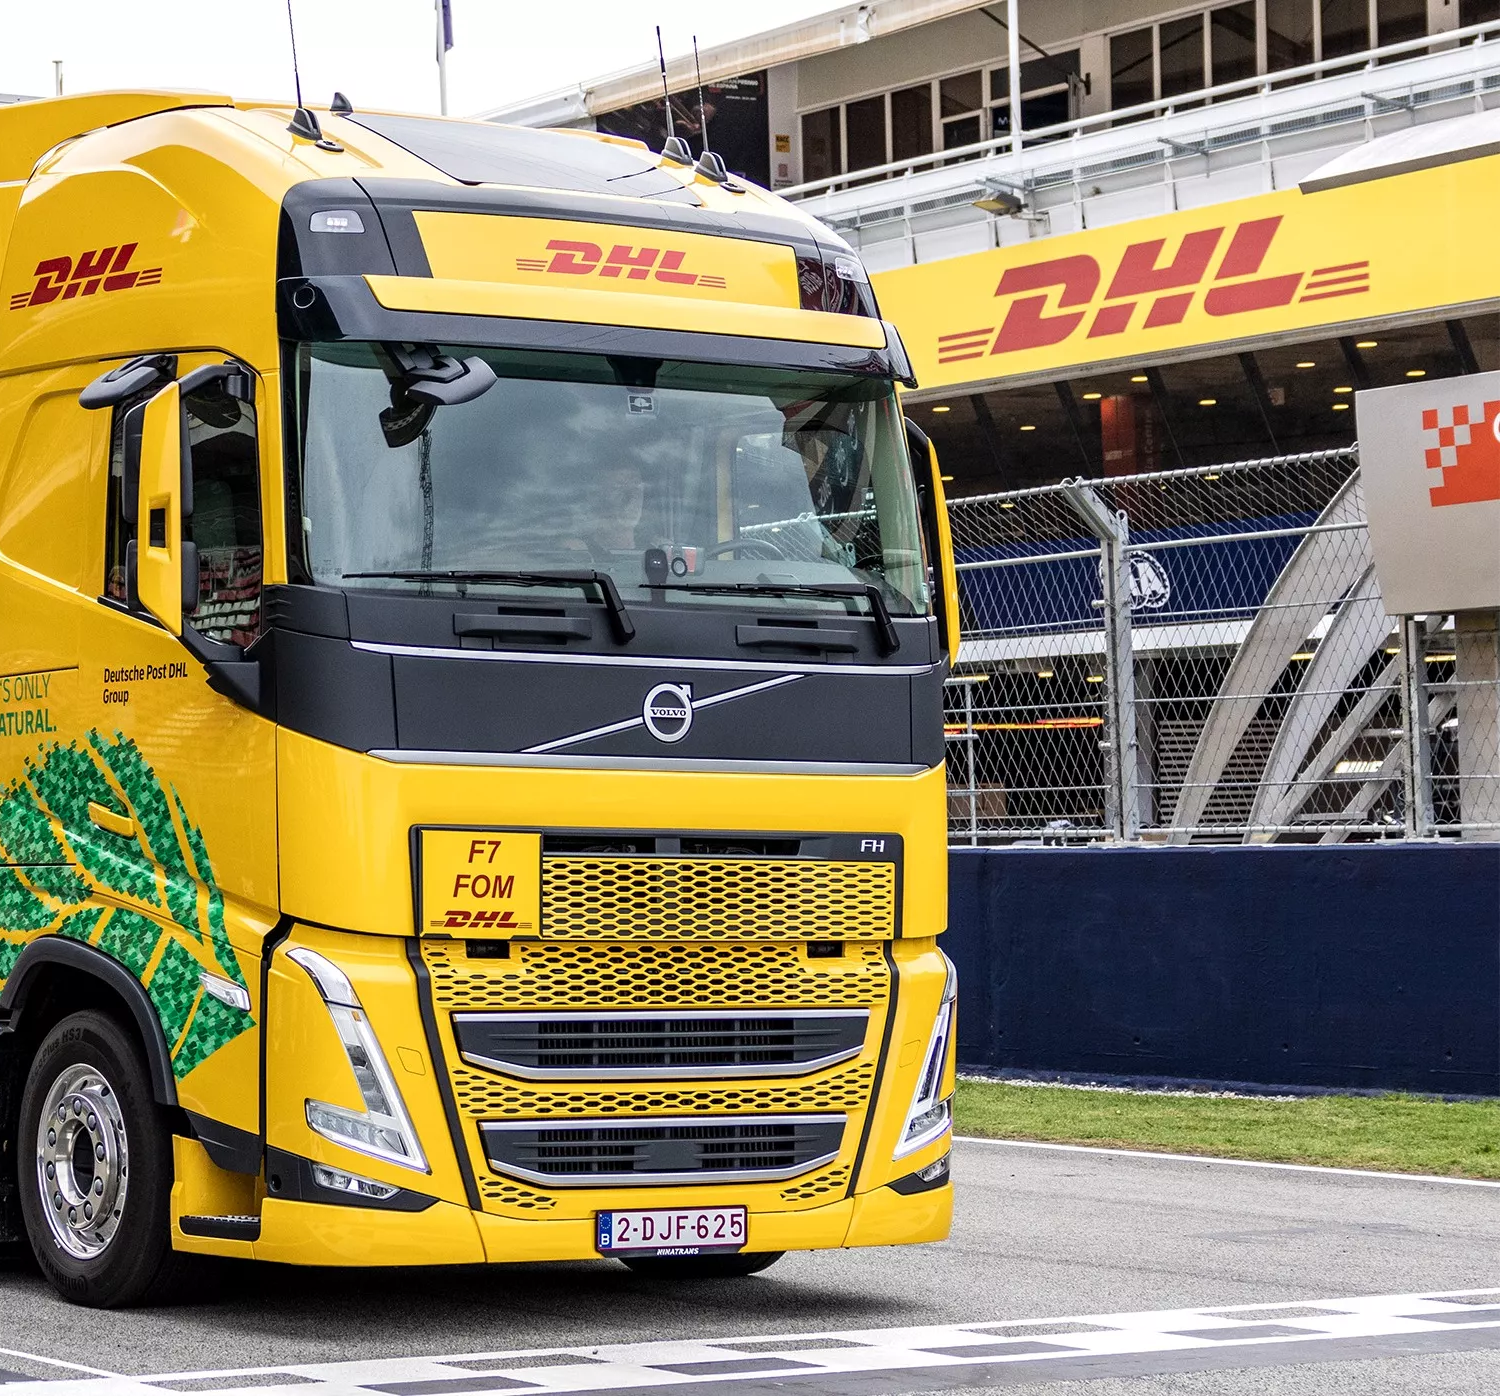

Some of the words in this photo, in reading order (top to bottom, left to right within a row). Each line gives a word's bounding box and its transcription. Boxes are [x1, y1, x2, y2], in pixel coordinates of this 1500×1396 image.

[27, 242, 141, 307] DHL
[546, 240, 698, 286] DHL
[991, 215, 1304, 355] DHL
[104, 665, 144, 683] Deutsche
[146, 664, 167, 680] Post
[168, 662, 188, 678] DHL
[14, 674, 51, 701] ONLY
[103, 688, 129, 706] Group
[468, 840, 502, 864] F7
[860, 839, 885, 853] FH
[452, 874, 515, 899] FOM
[443, 910, 519, 928] DHL
[62, 1027, 81, 1043] HS3
[601, 1233, 610, 1246] B
[617, 1213, 743, 1242] 2-DJF-625
[656, 1247, 700, 1256] NINATRANS
